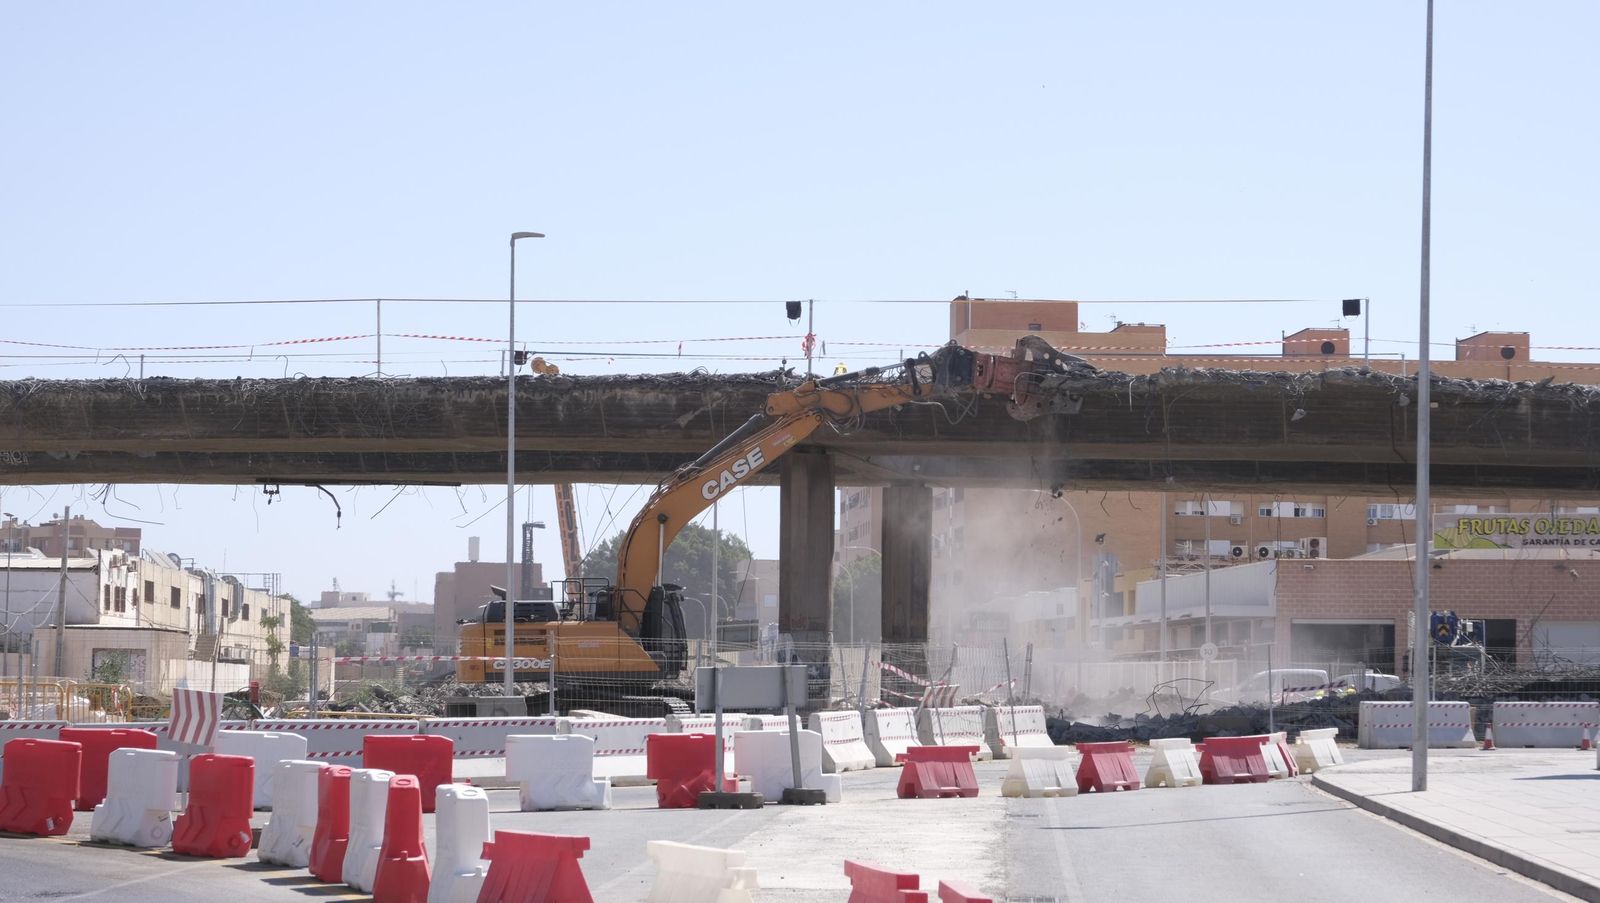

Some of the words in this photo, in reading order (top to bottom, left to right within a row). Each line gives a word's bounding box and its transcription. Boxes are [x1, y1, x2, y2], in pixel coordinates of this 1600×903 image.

[702, 447, 765, 500] CASE
[1457, 517, 1530, 536] FRUTAS
[1573, 538, 1587, 546] DE
